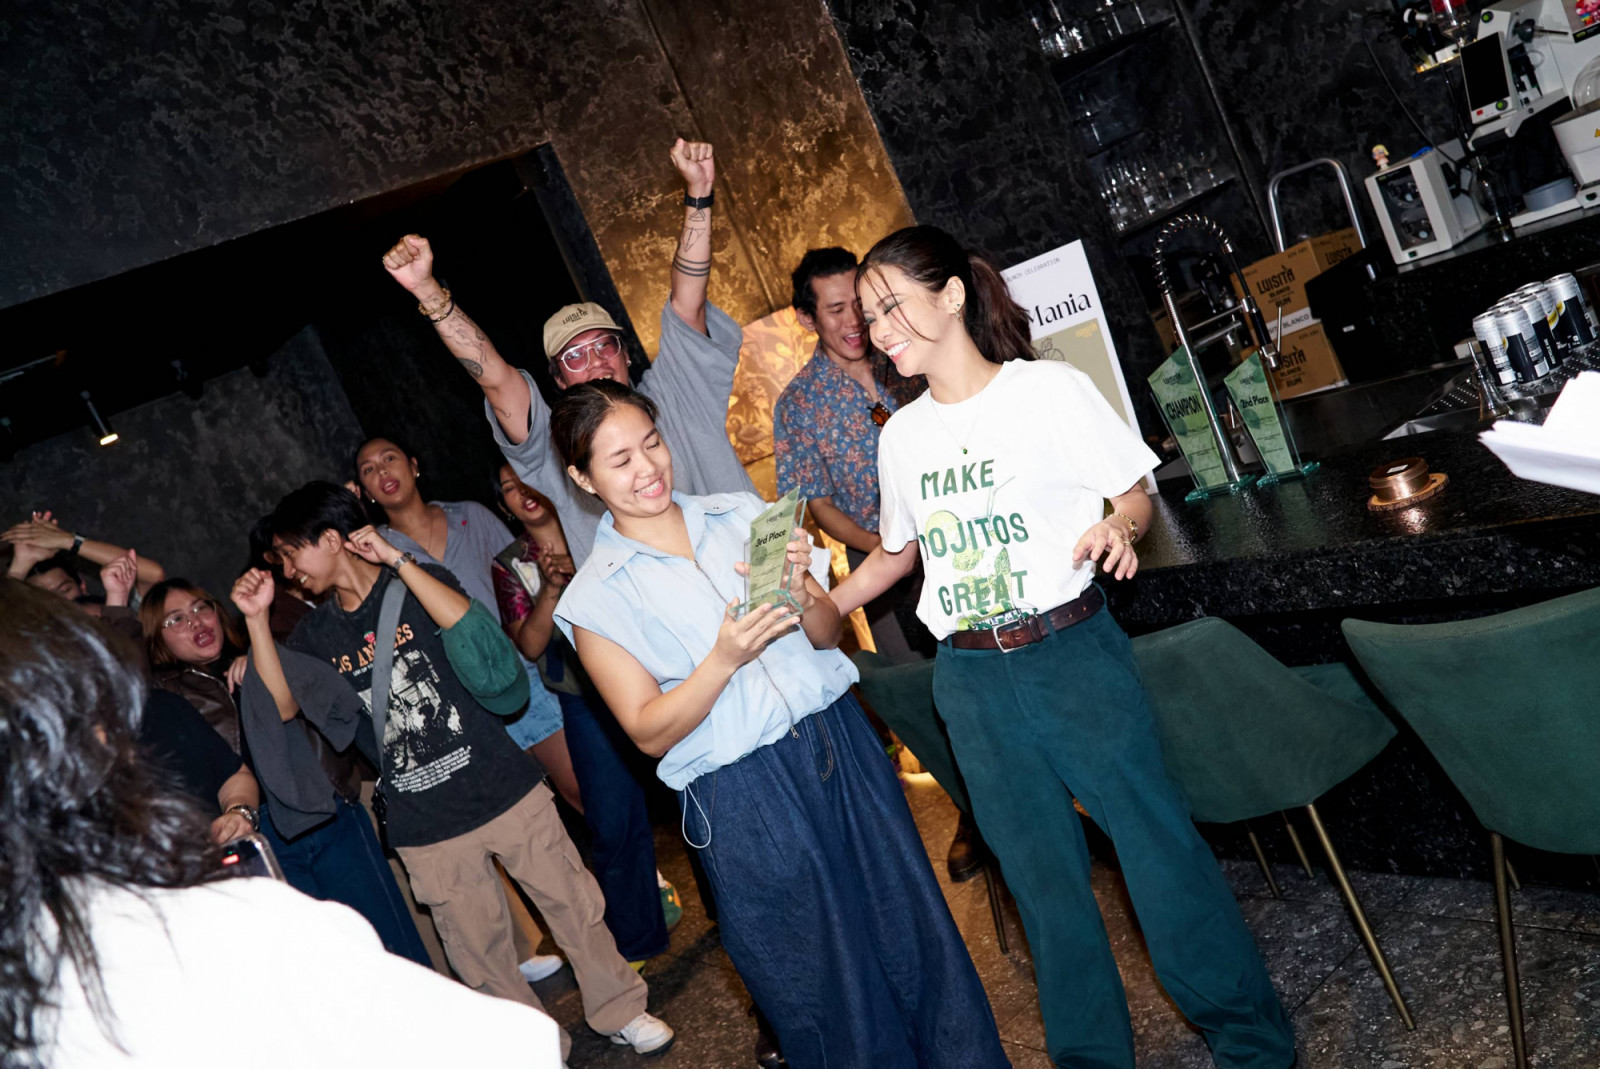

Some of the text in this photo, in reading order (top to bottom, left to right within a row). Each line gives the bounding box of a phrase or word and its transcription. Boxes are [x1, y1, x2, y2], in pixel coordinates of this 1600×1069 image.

[1025, 257, 1060, 276] CELEBRATION
[1275, 296, 1292, 308] RUM
[1283, 313, 1310, 328] BLANCO
[1166, 394, 1202, 420] CHAMPION
[1240, 395, 1270, 408] 2nd Place
[921, 459, 994, 500] MAKE
[755, 529, 787, 547] 3rd Place
[938, 570, 1027, 616] GREAT
